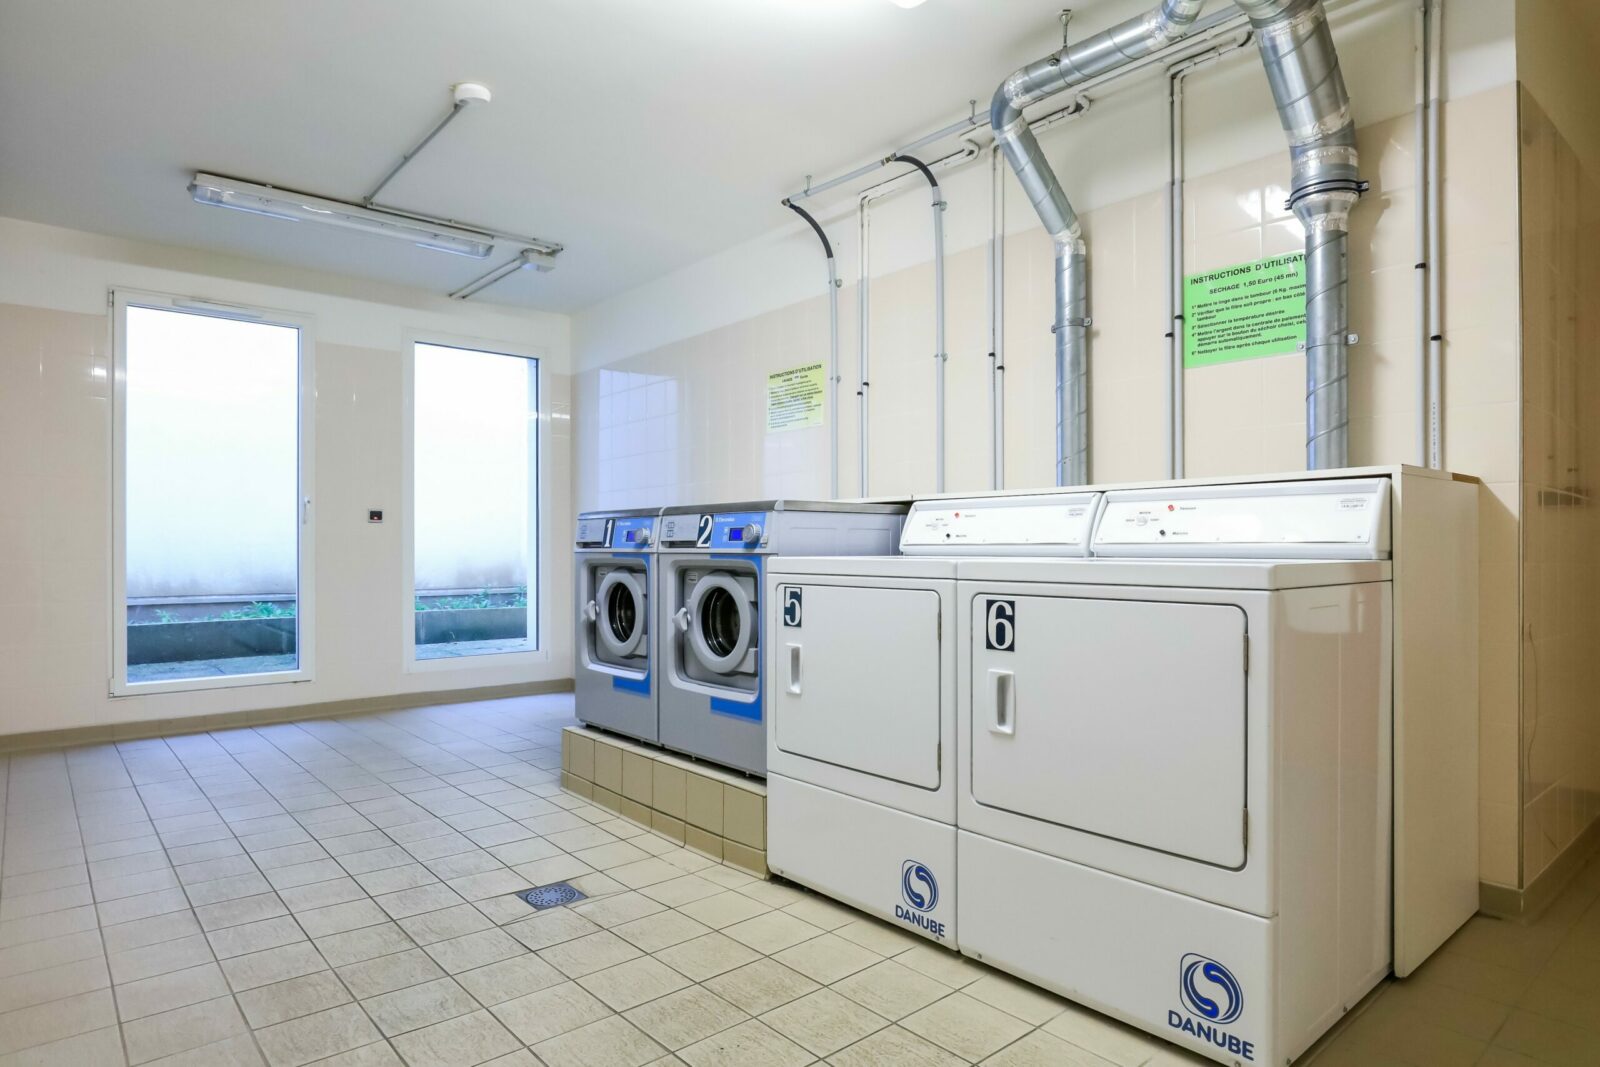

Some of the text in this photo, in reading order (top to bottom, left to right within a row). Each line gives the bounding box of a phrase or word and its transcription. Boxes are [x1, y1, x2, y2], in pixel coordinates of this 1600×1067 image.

[1191, 266, 1251, 285] INSTRUCTIONS
[1210, 284, 1240, 294] SECHAGE
[1274, 274, 1284, 282] (45
[1250, 291, 1271, 299] tambour
[1233, 313, 1264, 323] température
[770, 370, 794, 379] INSTRUCTIONS
[604, 520, 613, 547] 1
[697, 515, 713, 548] 2
[784, 588, 802, 626] 5
[987, 601, 1014, 650] 6
[896, 904, 945, 938] DANUBE
[1168, 1010, 1254, 1061] DANUBE
